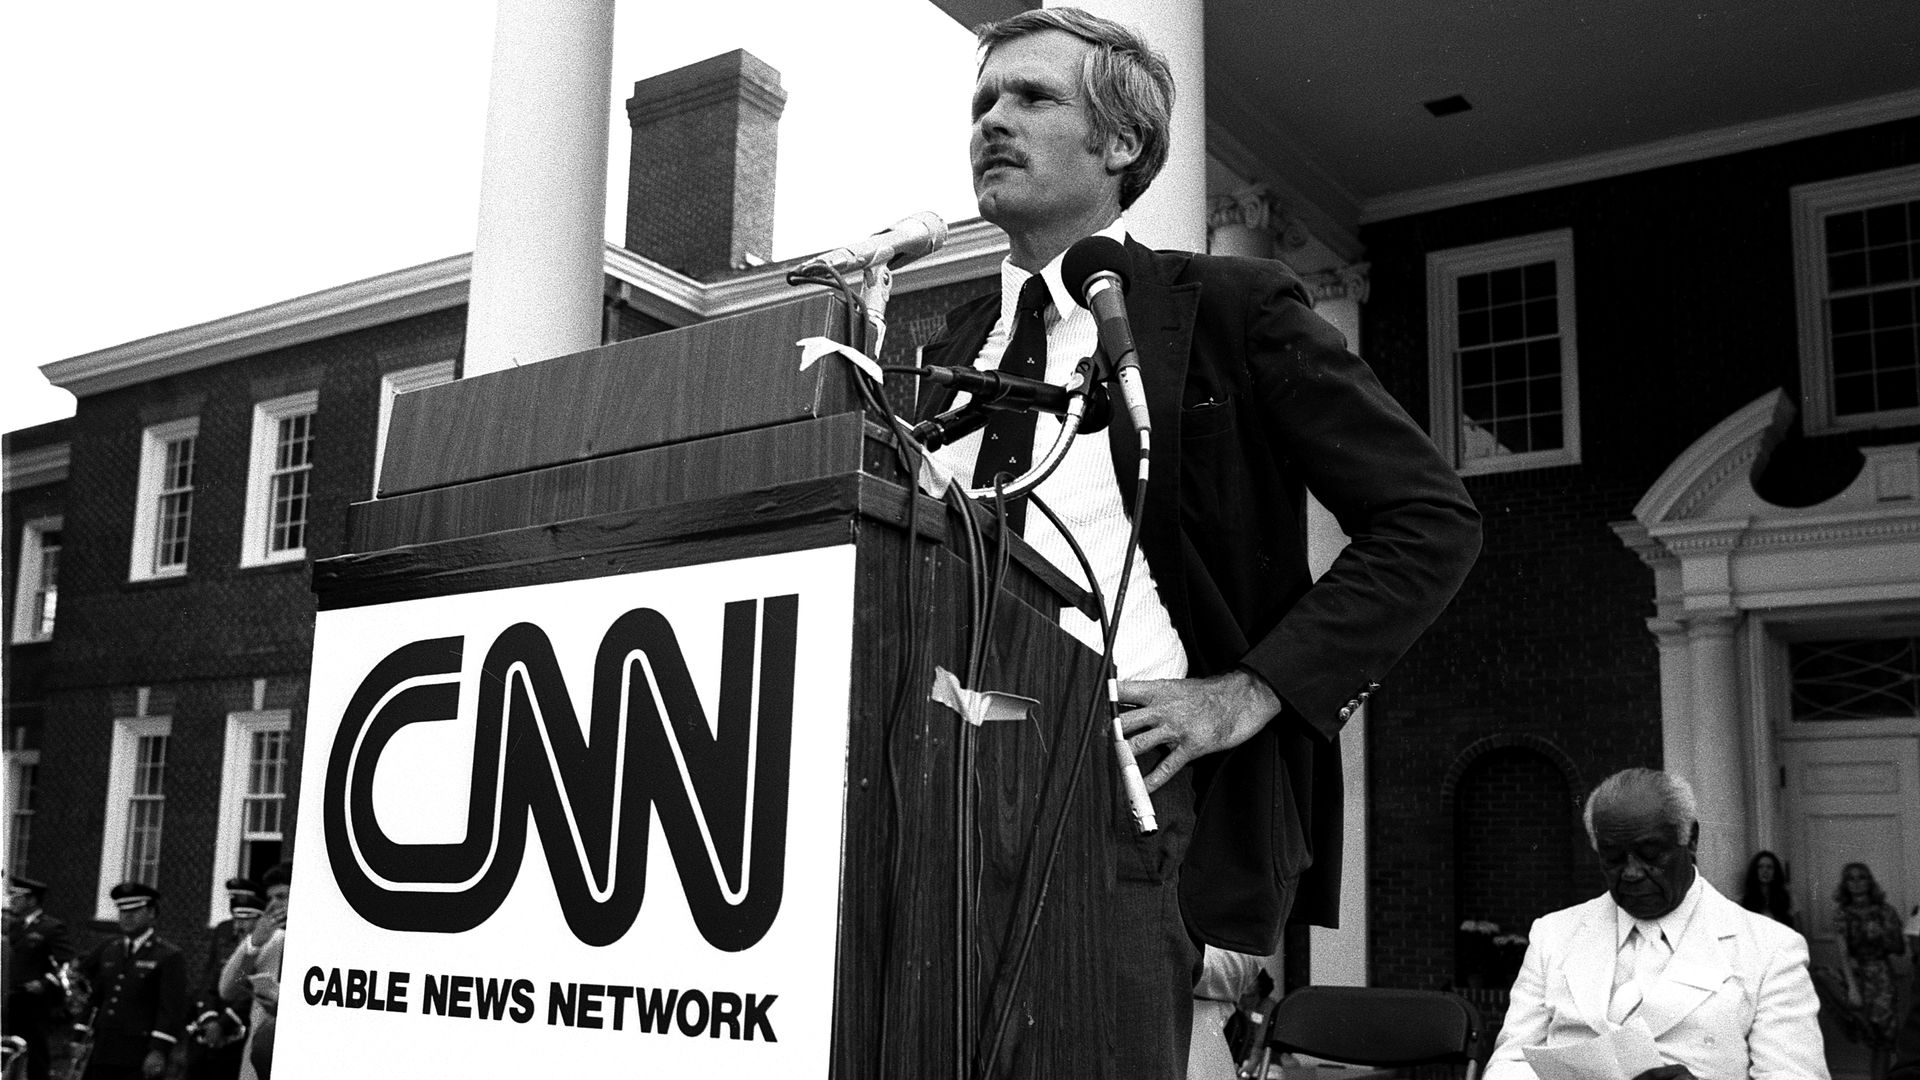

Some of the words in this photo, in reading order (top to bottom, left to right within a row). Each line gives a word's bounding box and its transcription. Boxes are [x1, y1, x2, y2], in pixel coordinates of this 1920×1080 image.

[324, 594, 799, 952] CNN
[303, 966, 410, 1013] CABLE
[423, 974, 534, 1023] NEWS
[548, 982, 778, 1042] NETWORK
